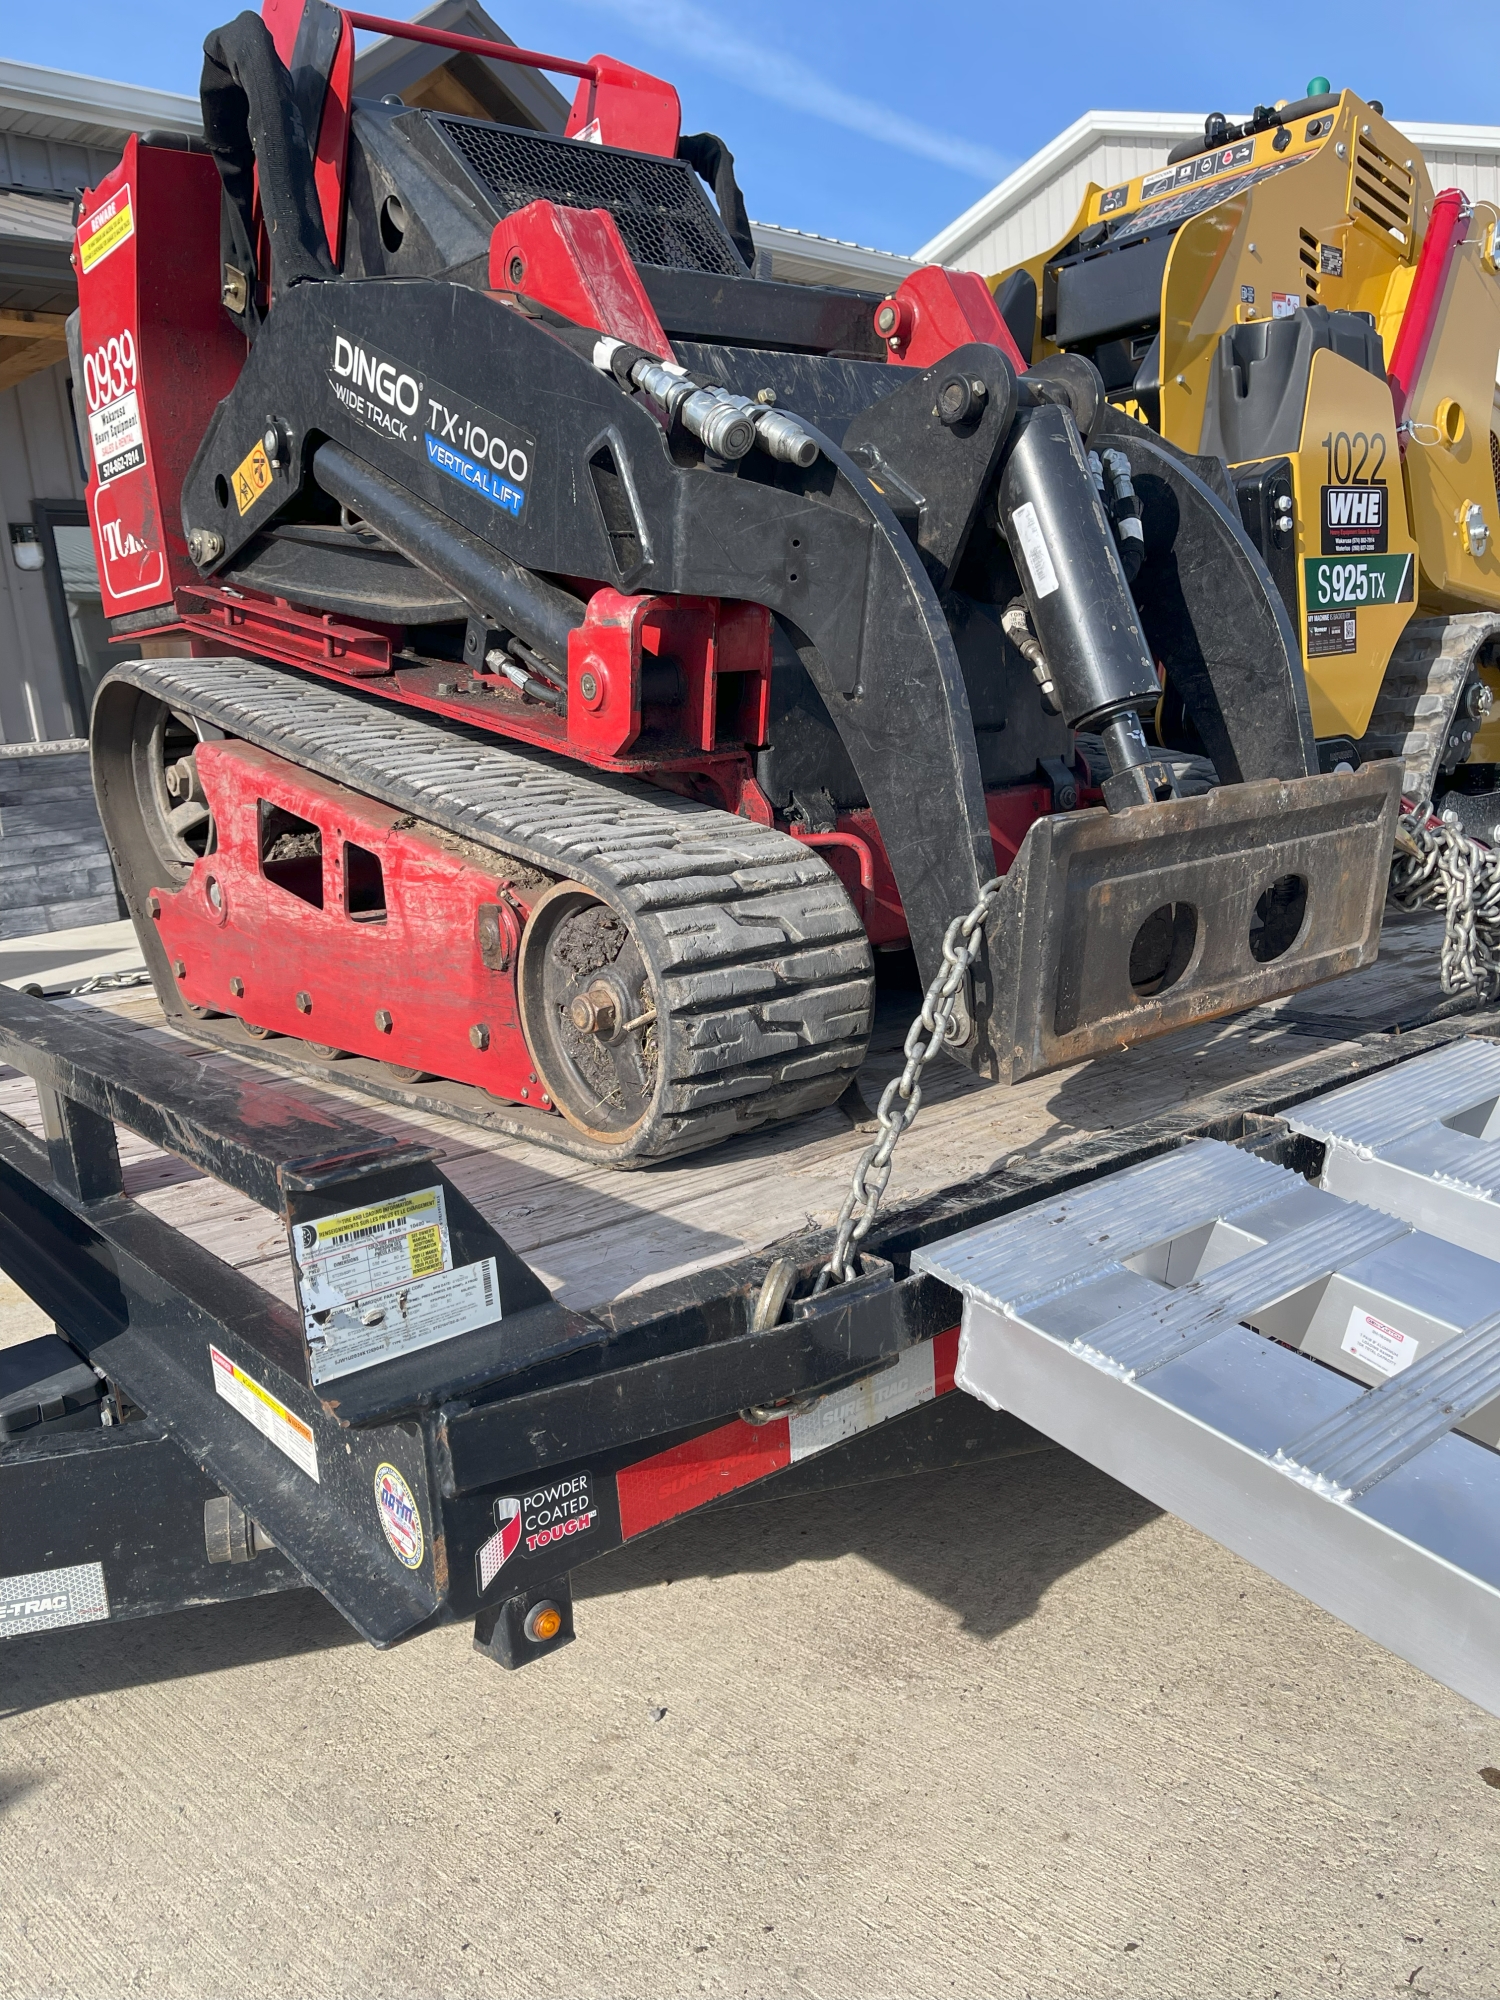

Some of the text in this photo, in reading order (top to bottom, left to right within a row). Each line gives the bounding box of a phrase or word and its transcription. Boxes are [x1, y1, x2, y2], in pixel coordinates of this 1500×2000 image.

[91, 201, 116, 233] BEWARE
[83, 329, 137, 411] 0939
[101, 406, 126, 427] Wakarusa
[335, 382, 409, 441] WIDE TRACK
[95, 414, 138, 446] Heavy Equipment
[102, 442, 114, 457] SALES
[118, 433, 134, 448] RENTAL
[428, 441, 521, 509] VERTICAL LIFT
[1322, 431, 1387, 485] 1022
[1329, 492, 1380, 525] WHE
[362, 1208, 383, 1219] LOADING
[822, 1377, 909, 1427] SURE-TRAC
[523, 1475, 588, 1512] POWDER
[525, 1495, 589, 1531] COATED
